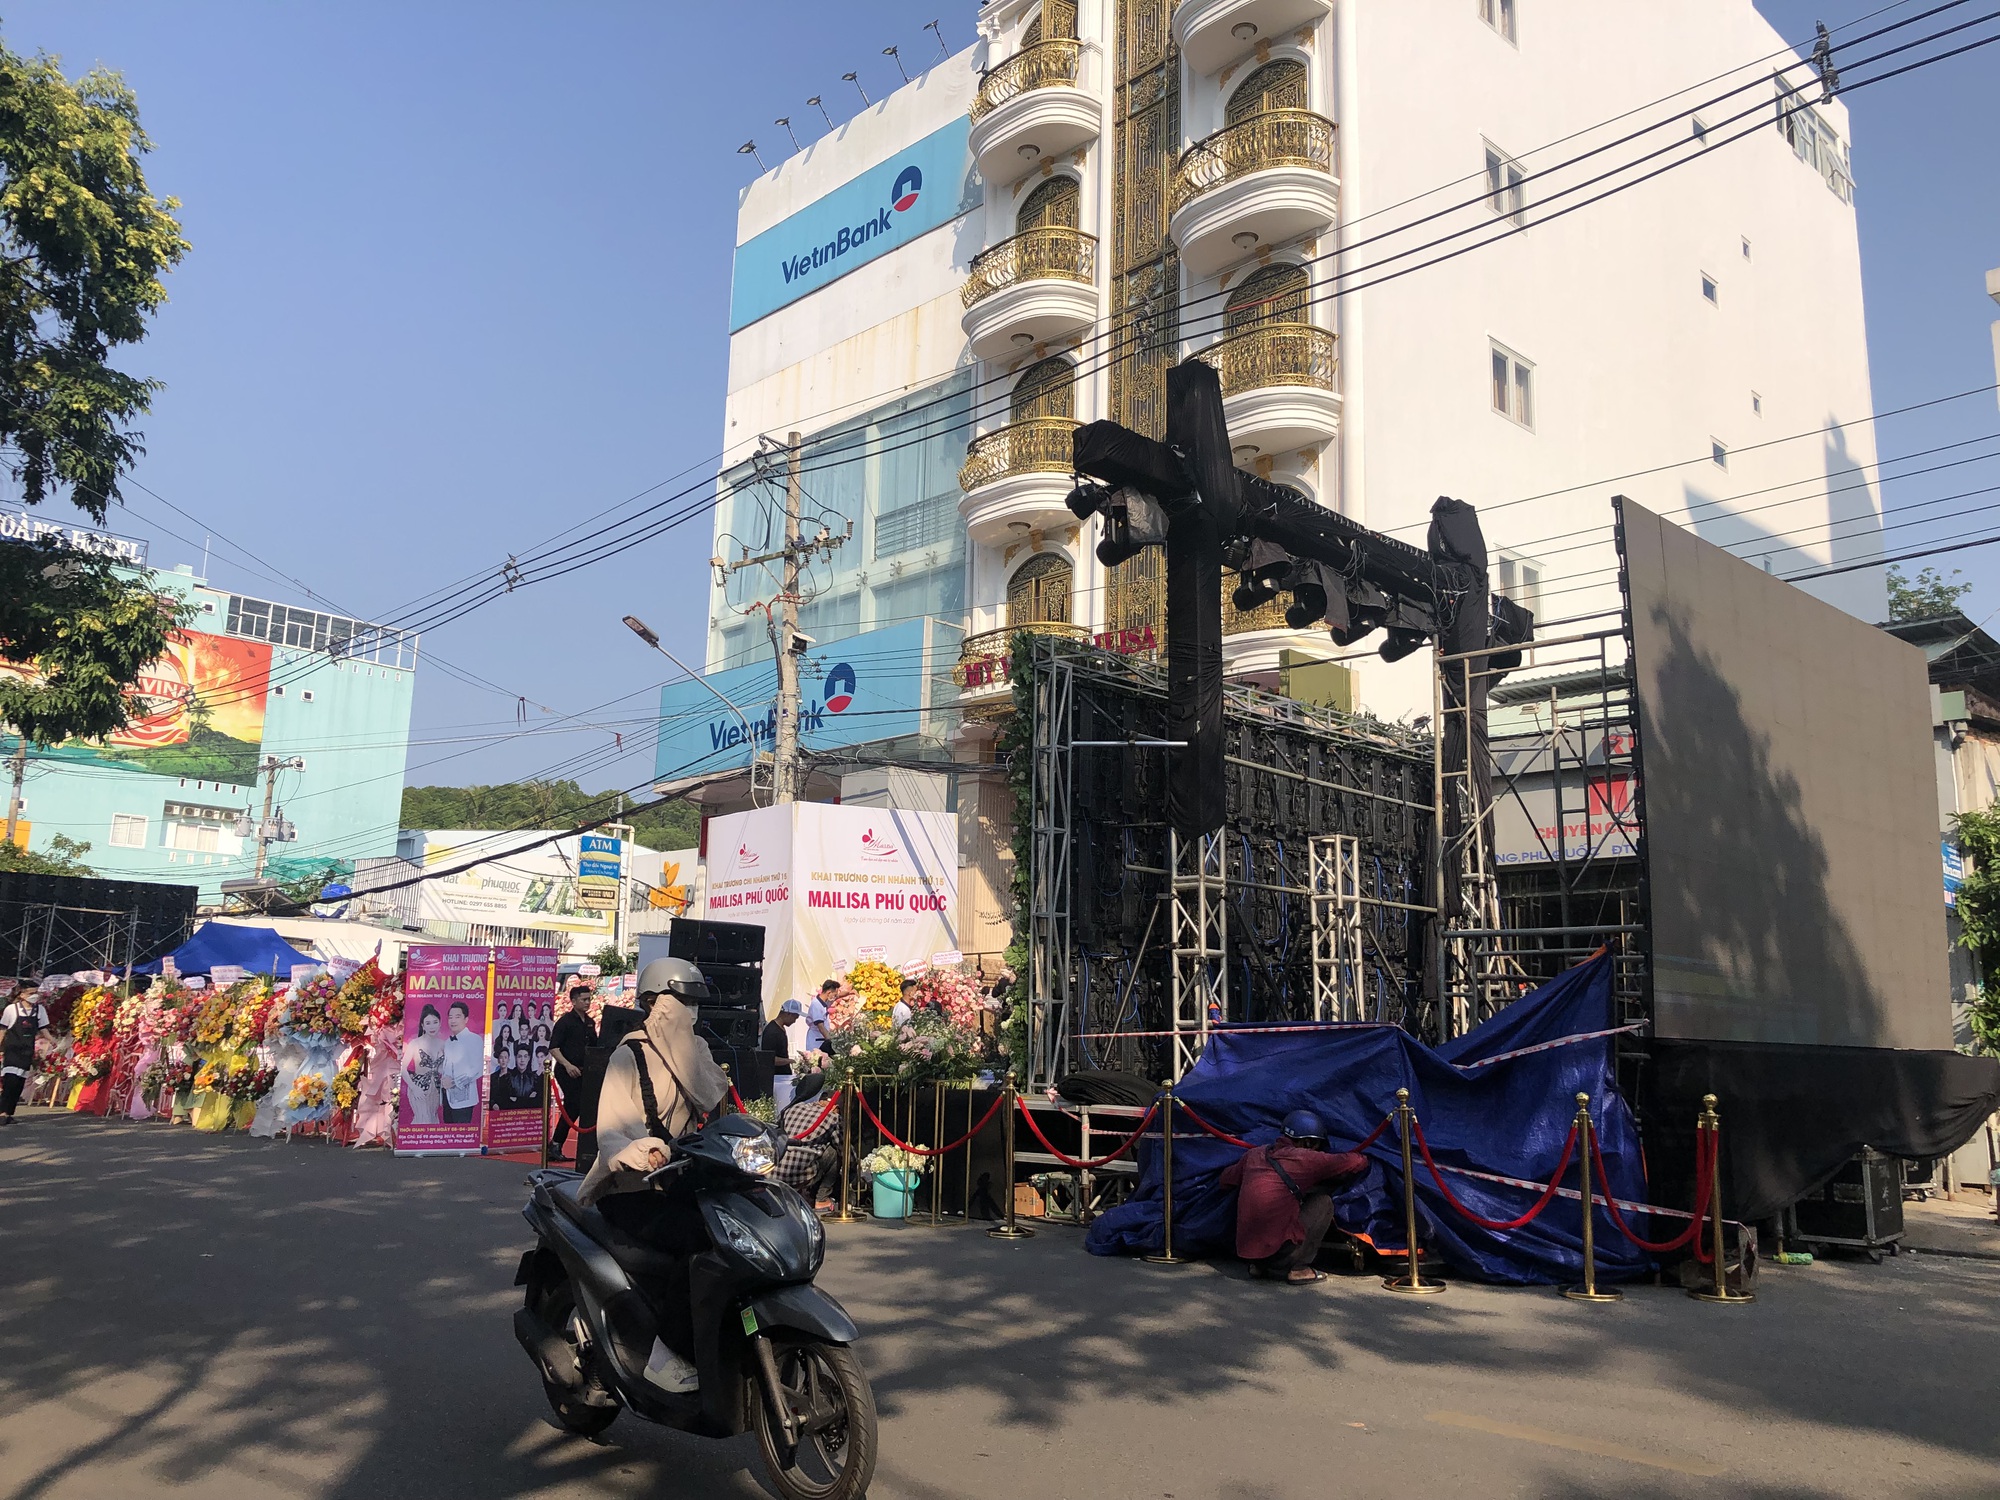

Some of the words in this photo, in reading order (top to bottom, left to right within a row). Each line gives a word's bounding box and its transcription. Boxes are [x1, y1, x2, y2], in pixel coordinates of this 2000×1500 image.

[782, 207, 893, 284] VietinBank
[71, 530, 142, 564] HOTEL
[964, 653, 993, 688] MỸ
[710, 699, 825, 750] VietinBnk
[1535, 822, 1602, 840] CHUYÊN
[589, 839, 612, 851] ATM
[811, 871, 832, 882] KHAI
[834, 873, 869, 883] TRƯƠNG
[871, 874, 886, 884] CHI
[888, 874, 916, 885] NHÁNH
[918, 875, 933, 886] THỨ
[935, 877, 944, 886] 15
[442, 898, 468, 906] HOTLINE:
[709, 893, 743, 909] MAILISA
[745, 887, 763, 905] PHÚ
[765, 882, 789, 905] QUỐC
[808, 890, 870, 909] MAILISA
[875, 889, 904, 910] PHÚ
[909, 889, 947, 913] QUỐC
[442, 953, 459, 963] KHAI
[461, 953, 488, 963] TRƯƠNG
[522, 955, 535, 964] KHAI
[536, 955, 557, 965] TRƯƠNG
[472, 965, 486, 973] VIỆN
[409, 975, 485, 990] MAILISA
[496, 975, 554, 990] MAILISA
[466, 991, 485, 999] QUỐC
